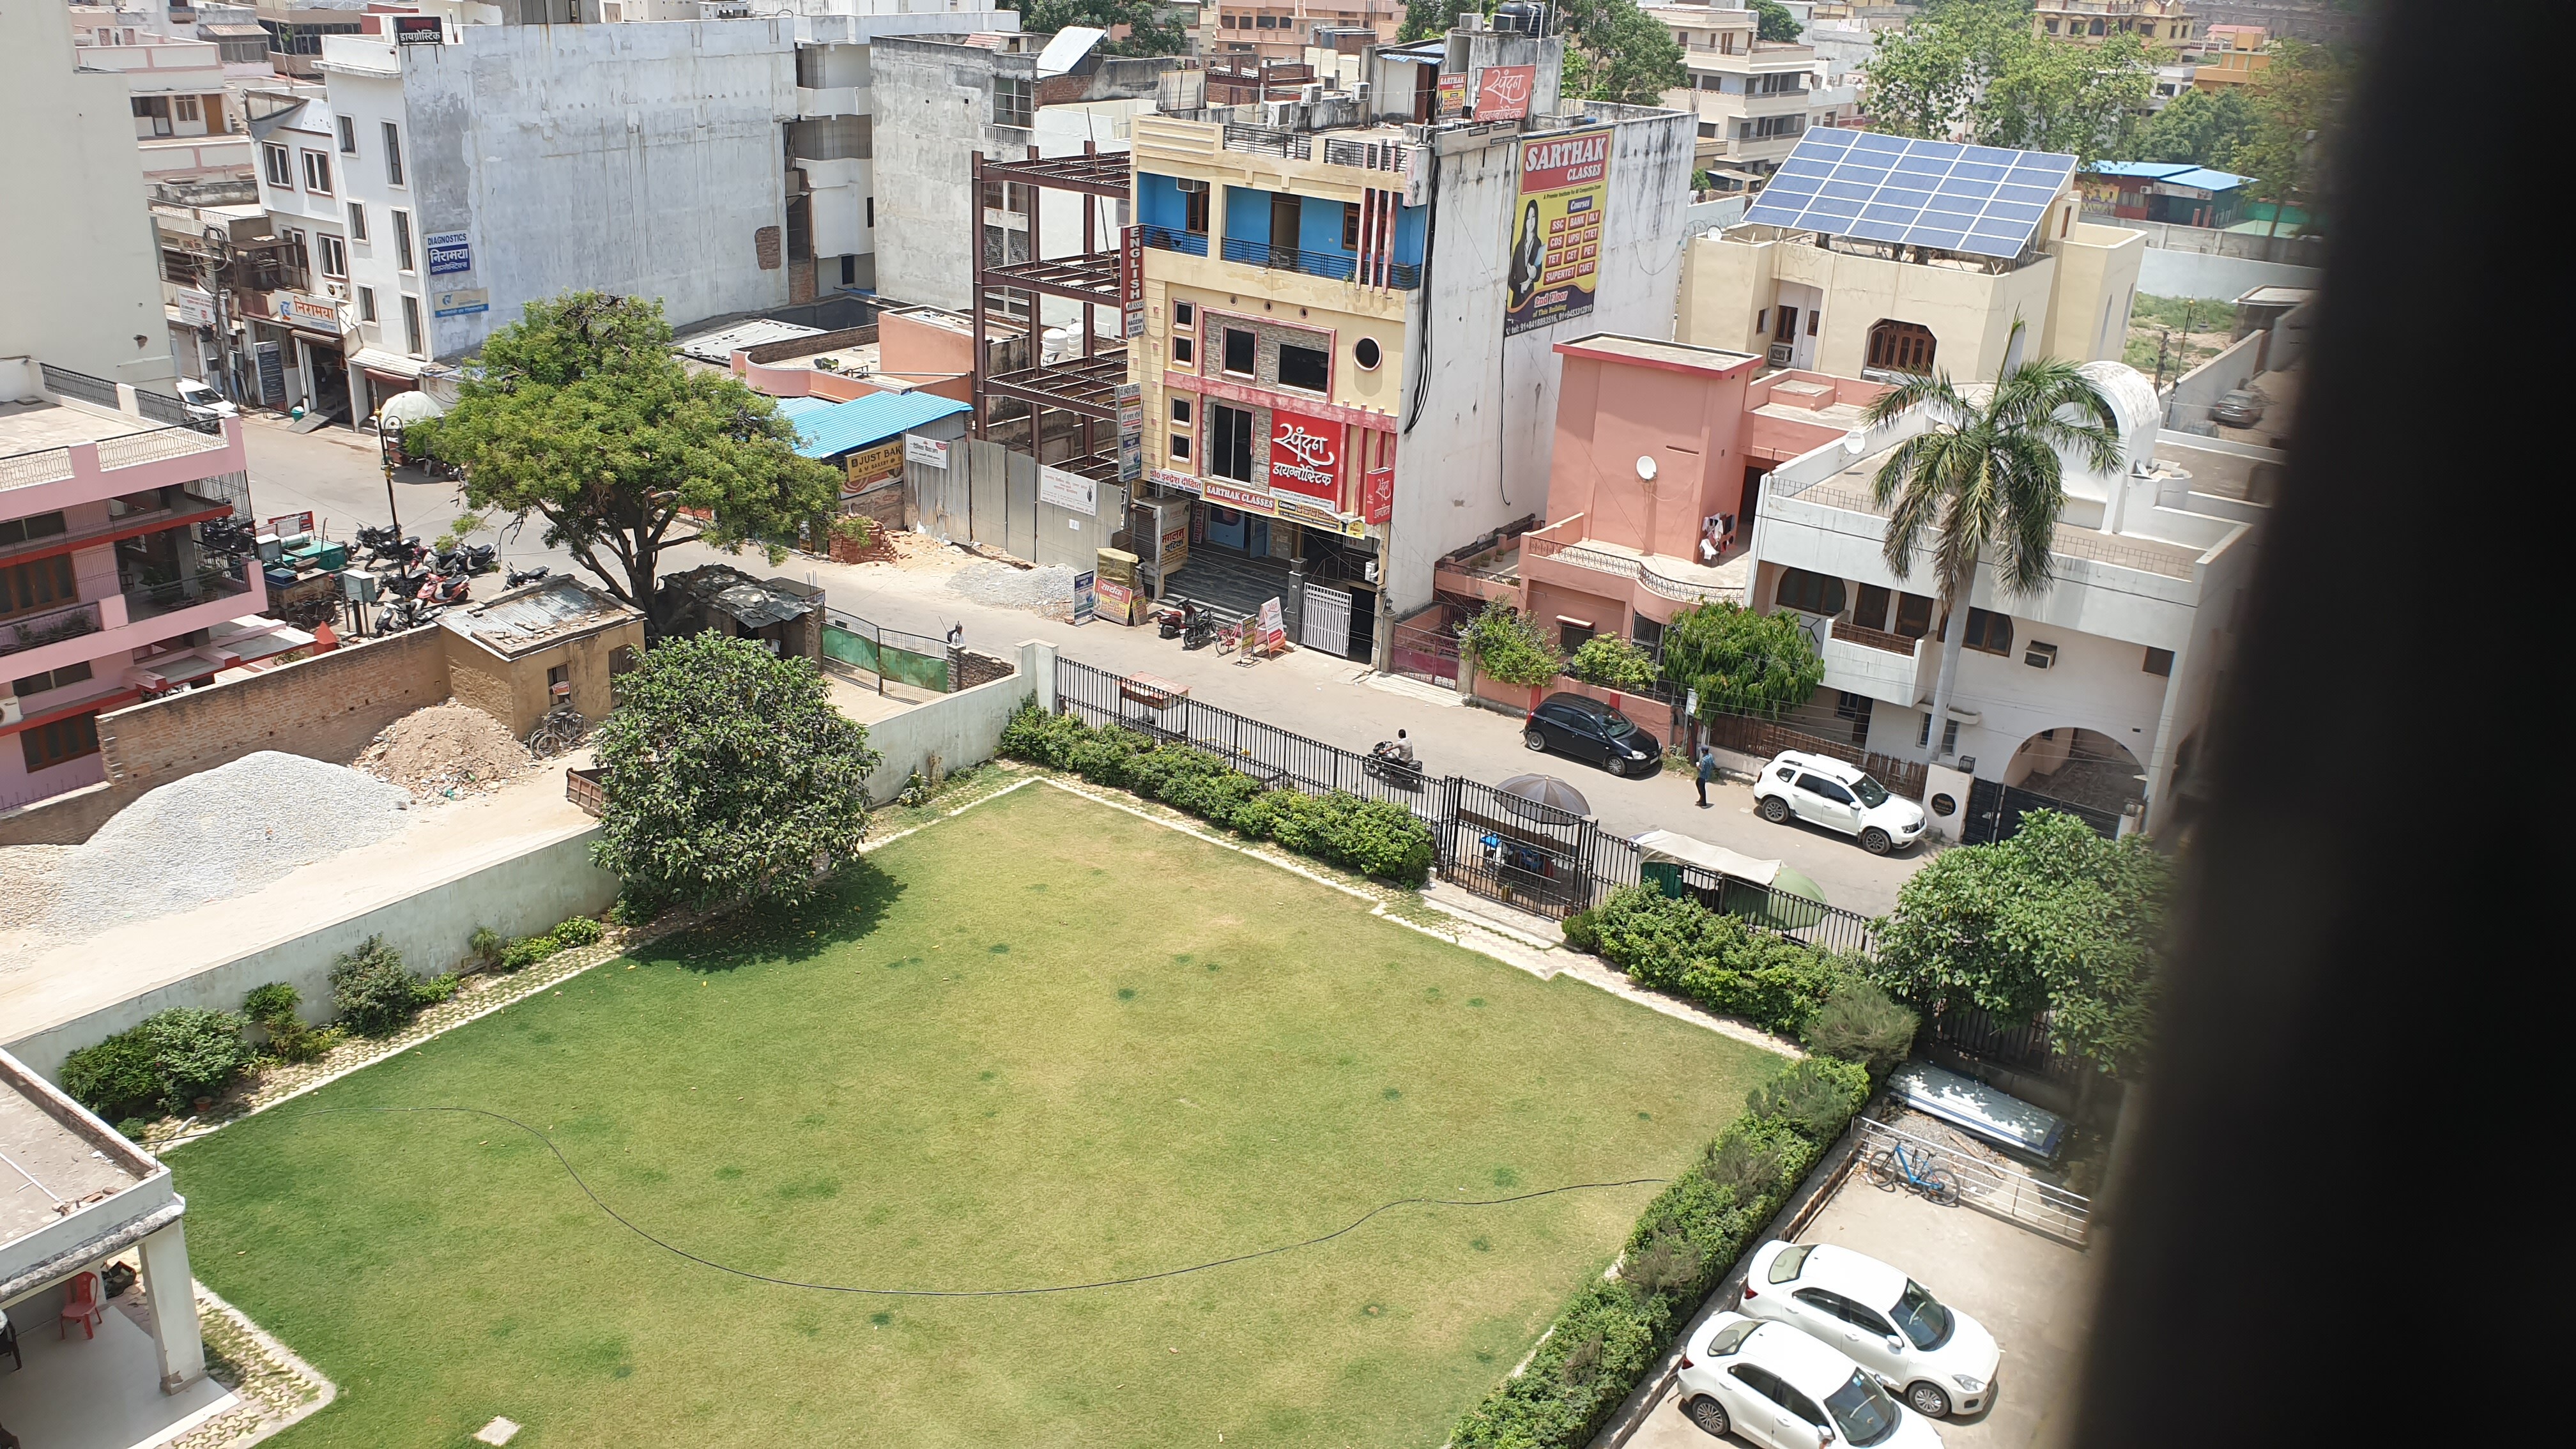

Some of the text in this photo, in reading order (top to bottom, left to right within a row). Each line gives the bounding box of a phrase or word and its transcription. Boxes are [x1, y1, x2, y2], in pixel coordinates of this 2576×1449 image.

[1525, 137, 1606, 172] SARTHAK
[1567, 164, 1602, 181] CLASSES
[1570, 200, 1590, 210] Courses
[1552, 219, 1564, 230] SSC
[1570, 216, 1584, 227] BANK
[427, 233, 467, 245] DIAGNOSTICS
[1550, 236, 1563, 247] CDS
[1584, 229, 1598, 239] CTET
[430, 249, 468, 263] निरामया
[1548, 245, 1595, 264] TET CET PET
[1130, 227, 1140, 300] ENGLISH
[1545, 261, 1593, 282] SUPERTET CUET
[1534, 291, 1568, 308] 2nd Floor
[293, 296, 334, 321] निरामया
[1272, 423, 1335, 467] स्पंदन
[859, 451, 881, 465] JUST
[1206, 485, 1240, 500] SARTHAK
[1241, 494, 1273, 509] CLASSES
[1101, 583, 1124, 597] सार्थक
